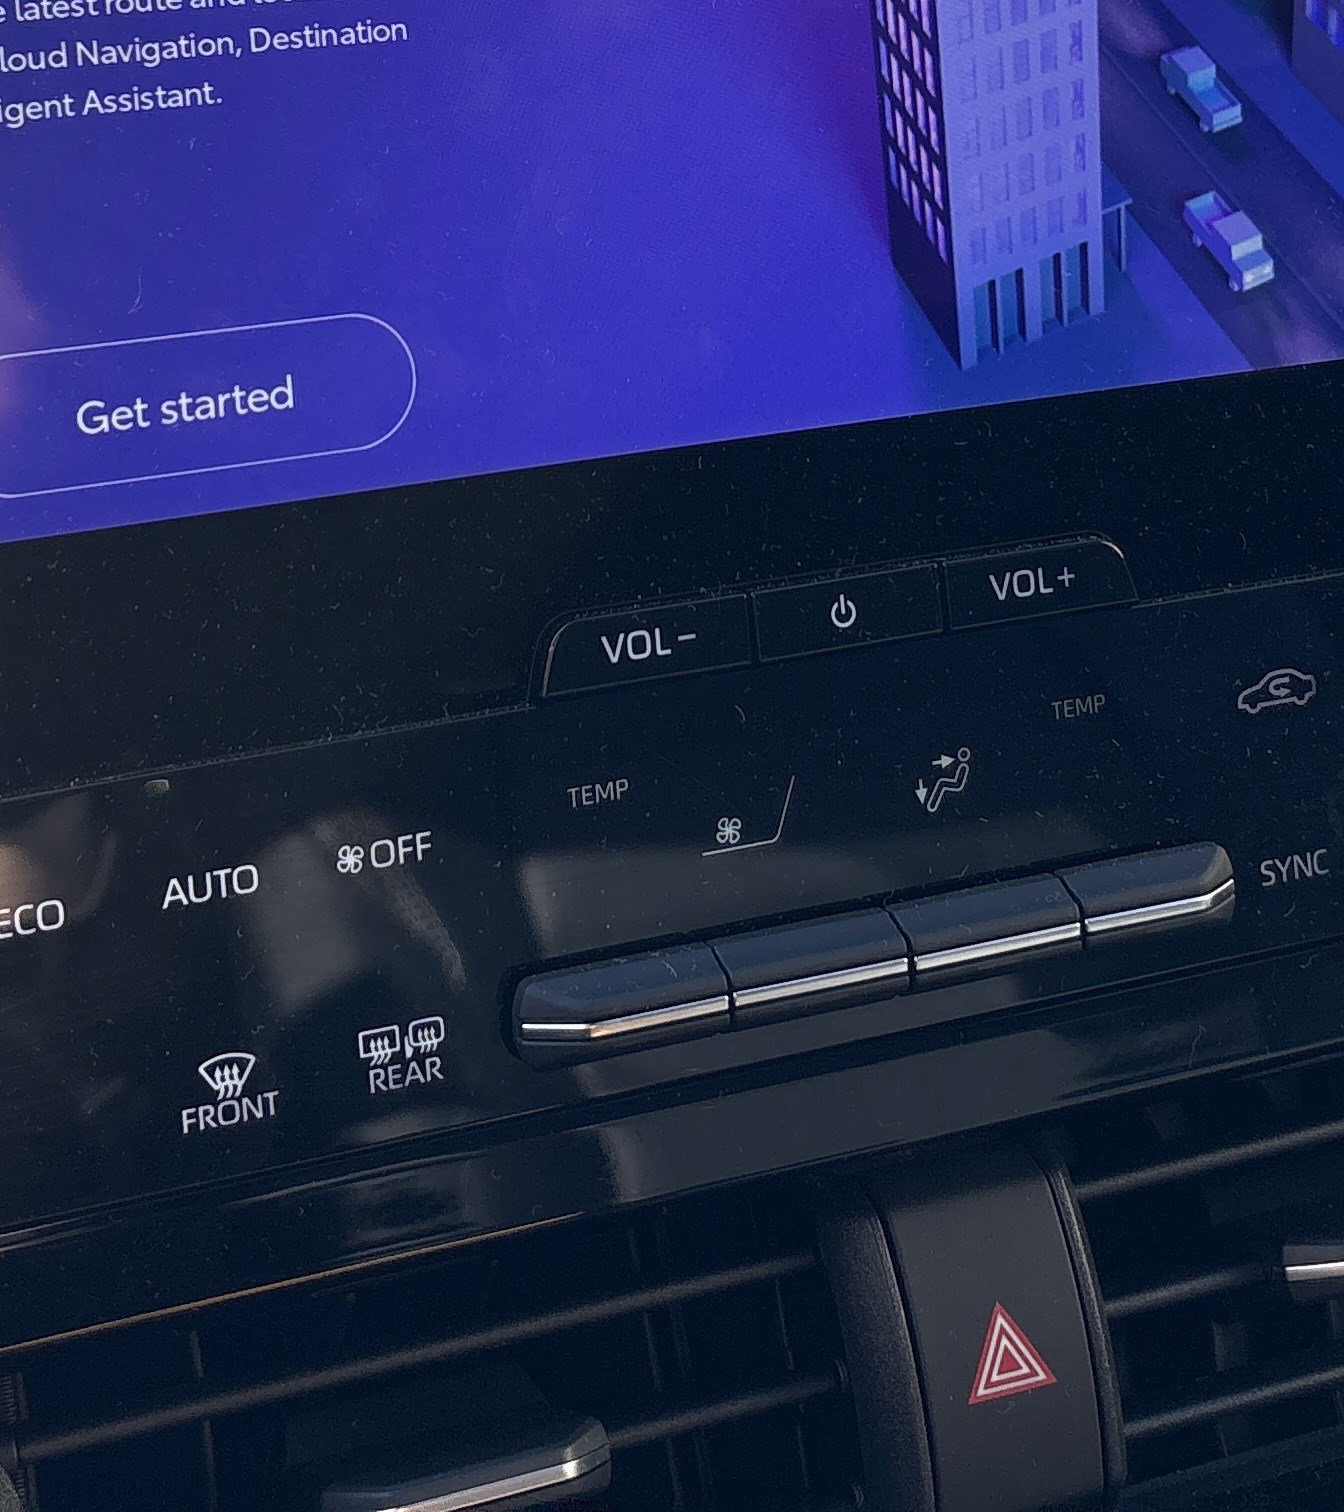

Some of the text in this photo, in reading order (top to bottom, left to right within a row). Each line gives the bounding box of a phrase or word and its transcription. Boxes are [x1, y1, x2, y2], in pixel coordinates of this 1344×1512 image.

[75, 30, 243, 72] Navigation,
[249, 16, 409, 54] Destination
[82, 80, 223, 116] Assistant.
[75, 374, 295, 437] Get started
[1051, 694, 1106, 720] TEMP
[567, 779, 630, 808] TEMP
[370, 832, 431, 868] OFF
[1260, 849, 1329, 886] SYNC
[162, 864, 259, 908] AUTO
[369, 1056, 444, 1093] REAR
[181, 1090, 279, 1133] FRONT
